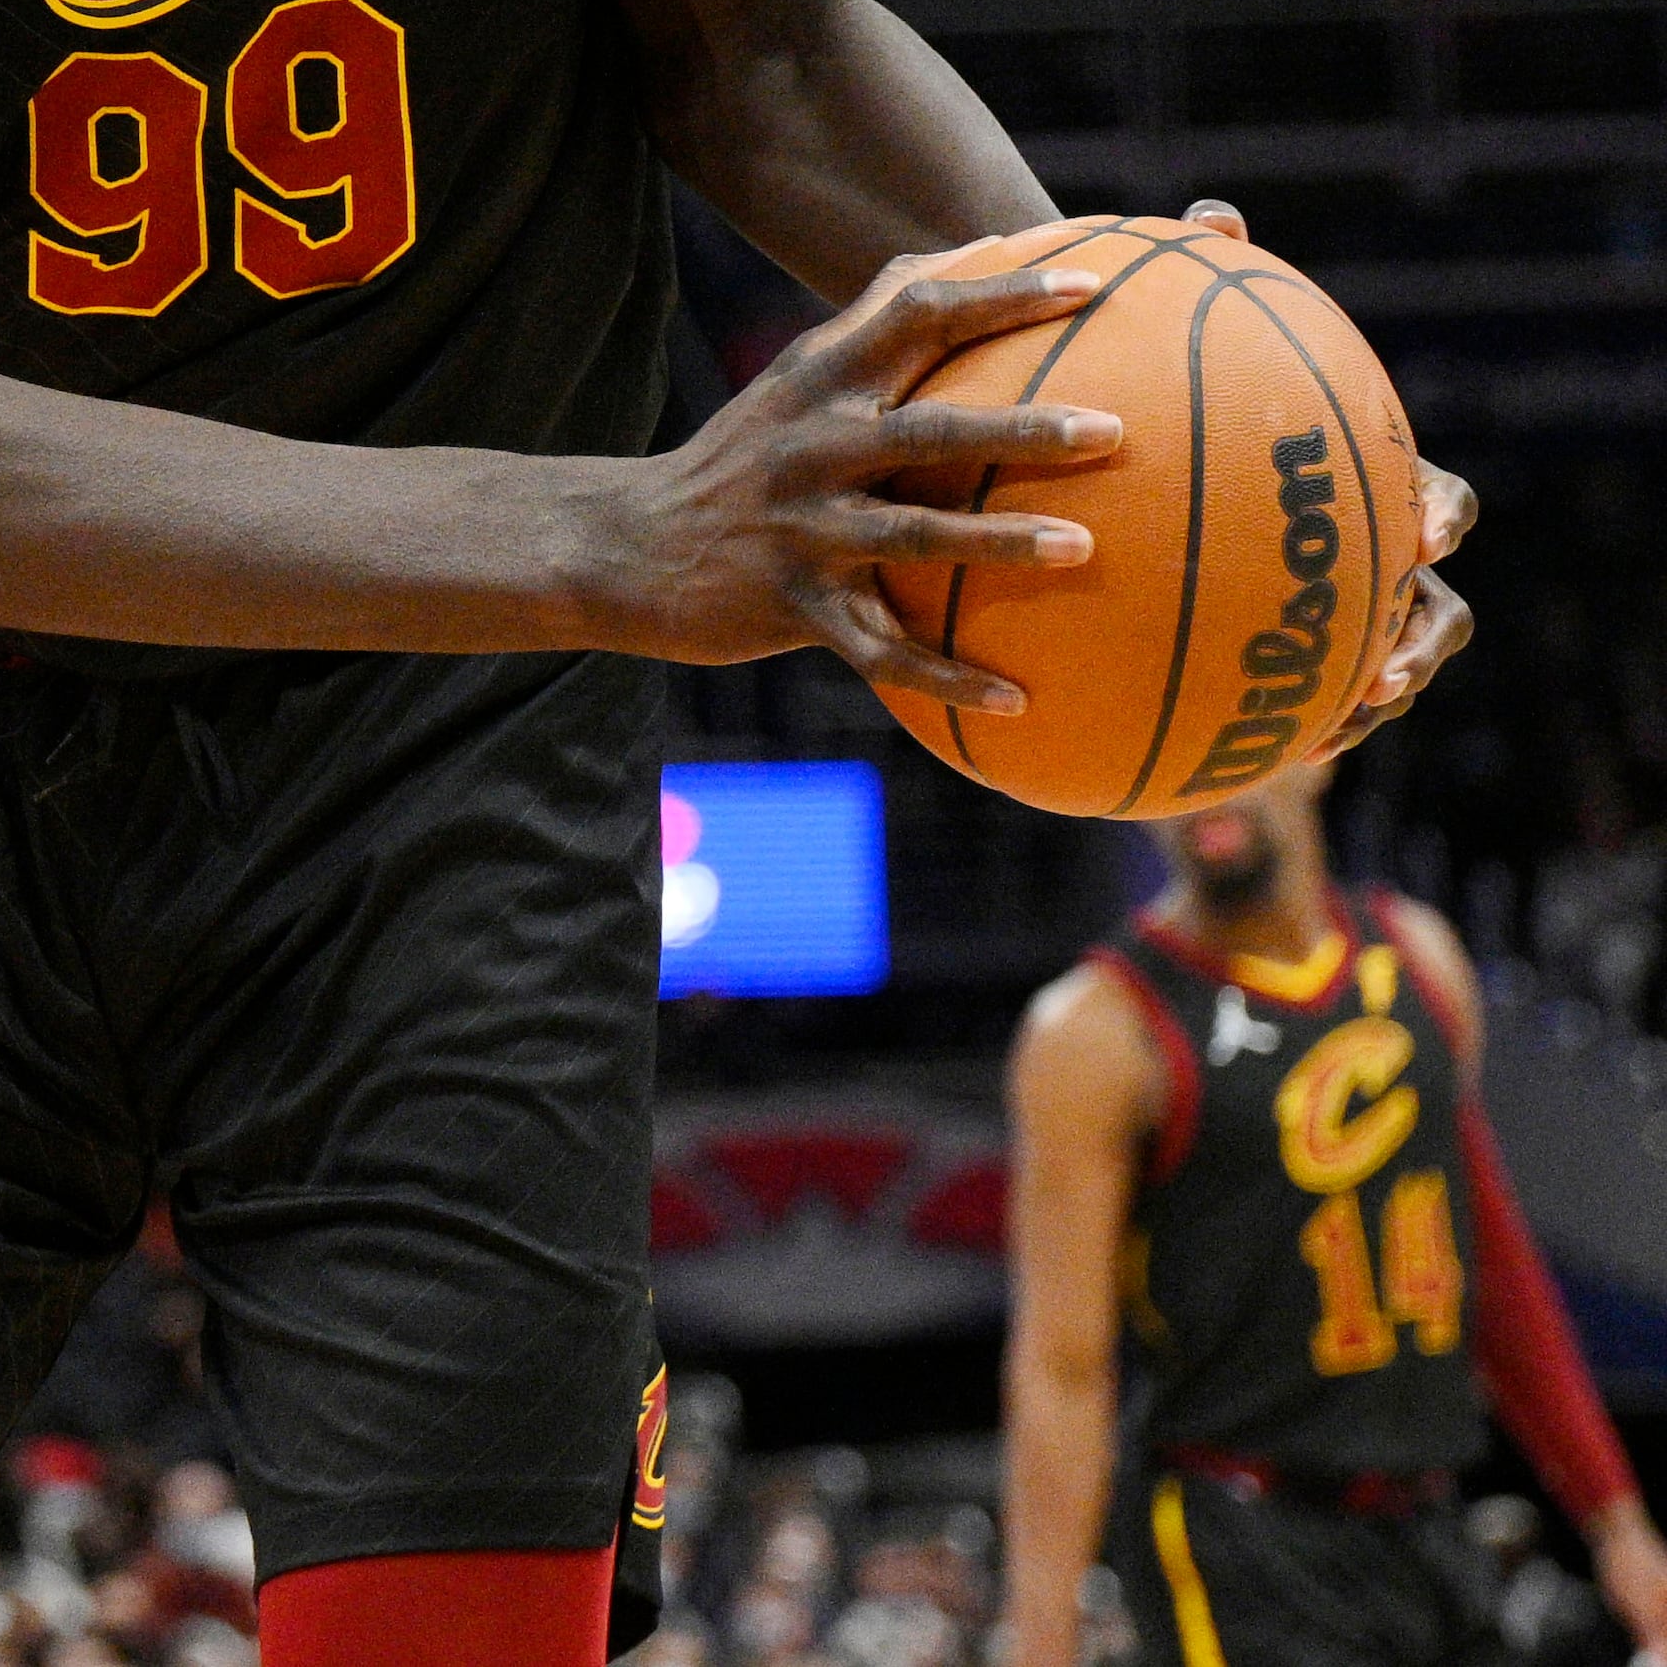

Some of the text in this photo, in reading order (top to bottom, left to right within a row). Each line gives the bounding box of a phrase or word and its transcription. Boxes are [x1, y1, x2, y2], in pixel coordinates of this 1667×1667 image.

[1174, 423, 1340, 799] Wilson
[1273, 1015, 1421, 1193] C
[1300, 1168, 1464, 1376] 14
